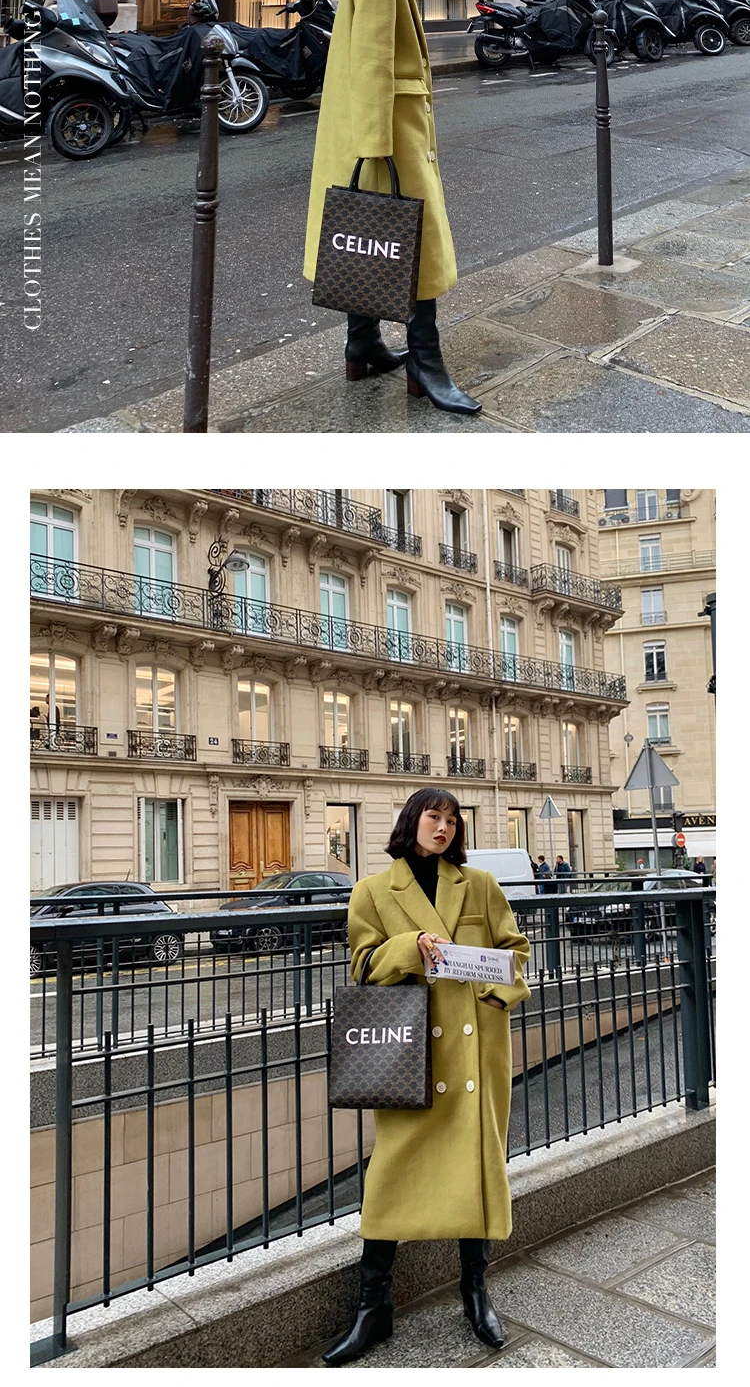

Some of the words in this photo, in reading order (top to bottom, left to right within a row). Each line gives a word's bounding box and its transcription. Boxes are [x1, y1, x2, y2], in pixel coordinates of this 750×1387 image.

[332, 233, 401, 260] CELINE
[684, 816, 715, 826] AVEN
[446, 959, 474, 970] HANGHAI
[474, 963, 503, 974] SPURRED
[452, 967, 477, 977] REFORM
[477, 973, 504, 982] SUCCESS
[345, 1026, 413, 1045] CELINE
